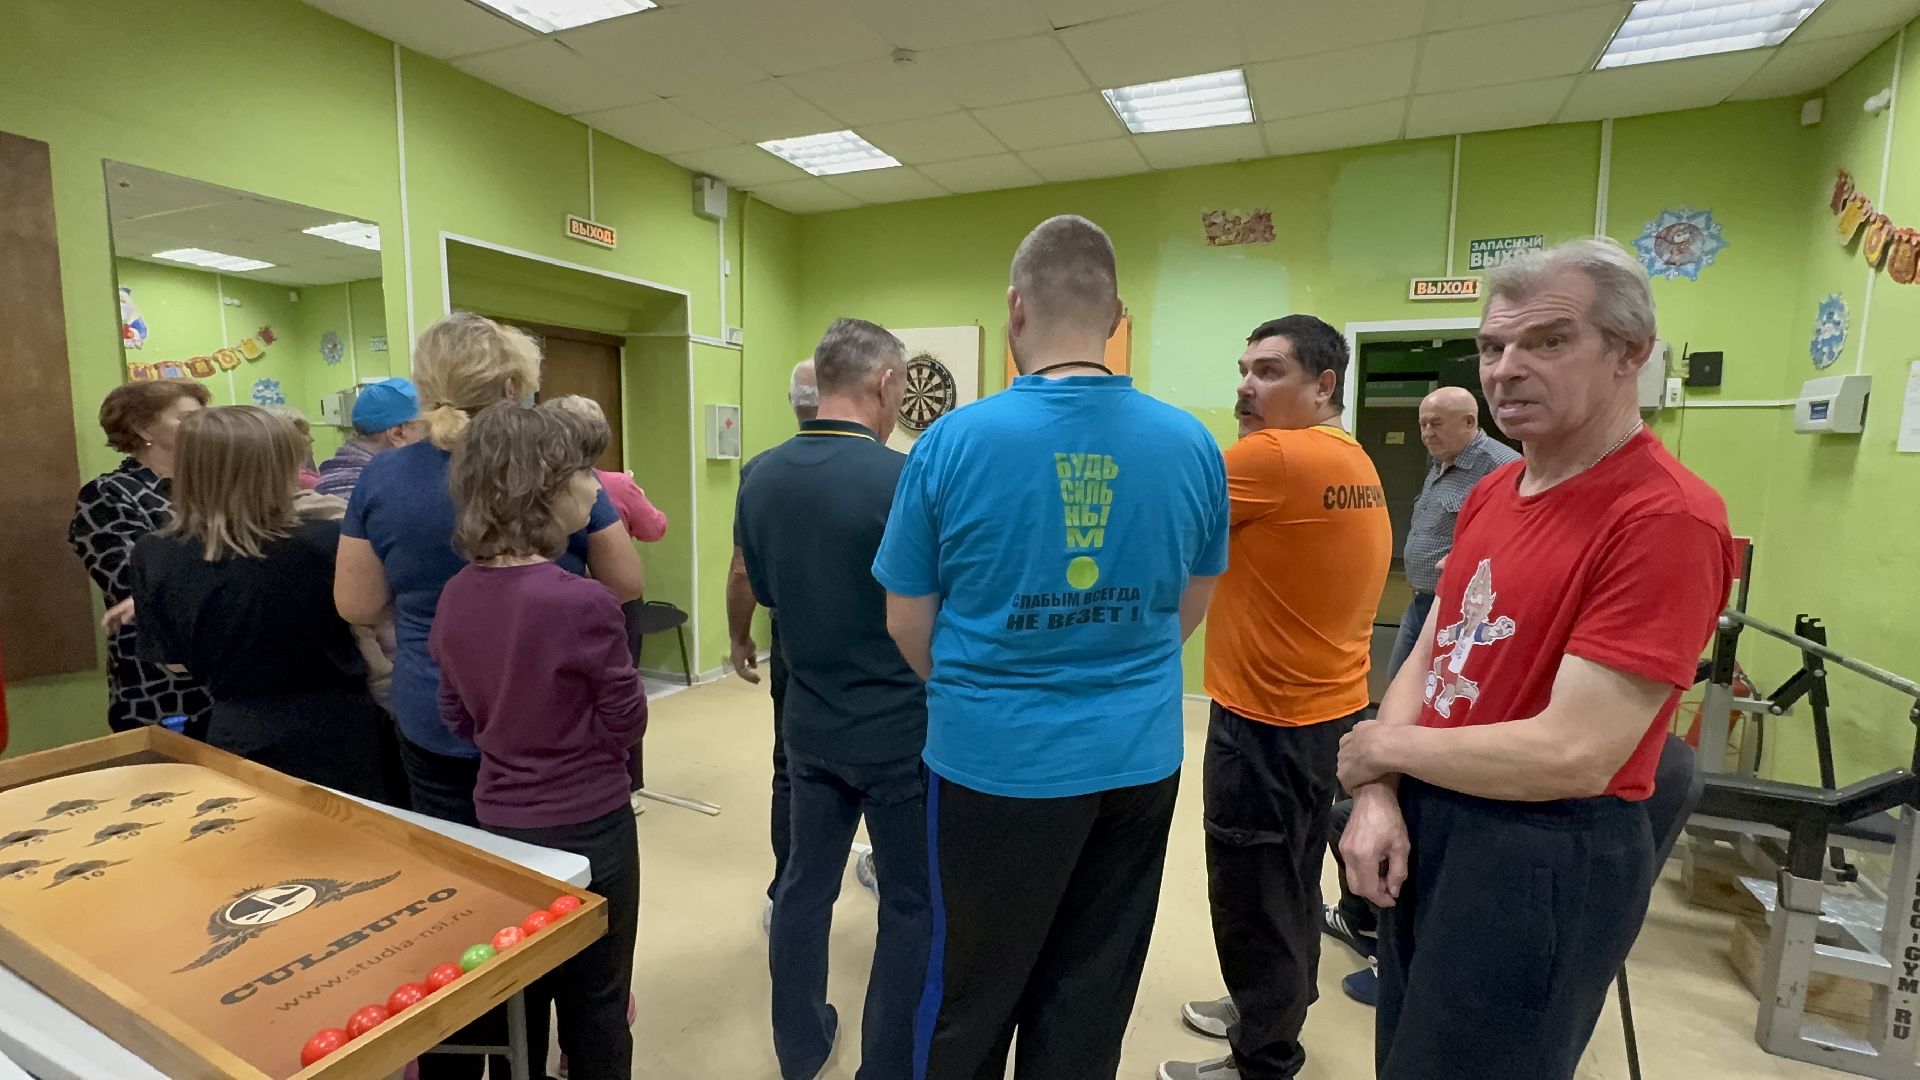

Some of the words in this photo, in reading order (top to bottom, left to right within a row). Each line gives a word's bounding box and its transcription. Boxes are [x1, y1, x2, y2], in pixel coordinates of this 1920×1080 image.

[571, 220, 613, 244] ВЫХОД
[1472, 236, 1542, 251] ЗАПАСНЫЙ
[1471, 249, 1541, 267] ВЫХ
[1417, 281, 1474, 295] ВЫХОД
[1054, 453, 1119, 480] БУДЬ
[1060, 480, 1113, 504] СИЛЬ
[1012, 592, 1080, 609] СЛАБЫМ
[1083, 587, 1140, 604] ВСЕГДА
[1006, 613, 1040, 630] НЕ
[1047, 606, 1123, 629] ВЕЗЕТ
[65, 805, 98, 817] 100
[80, 870, 105, 881] 10
[220, 887, 458, 1005] CULBUTO
[276, 907, 474, 1012] www.studia-nsi.ru
